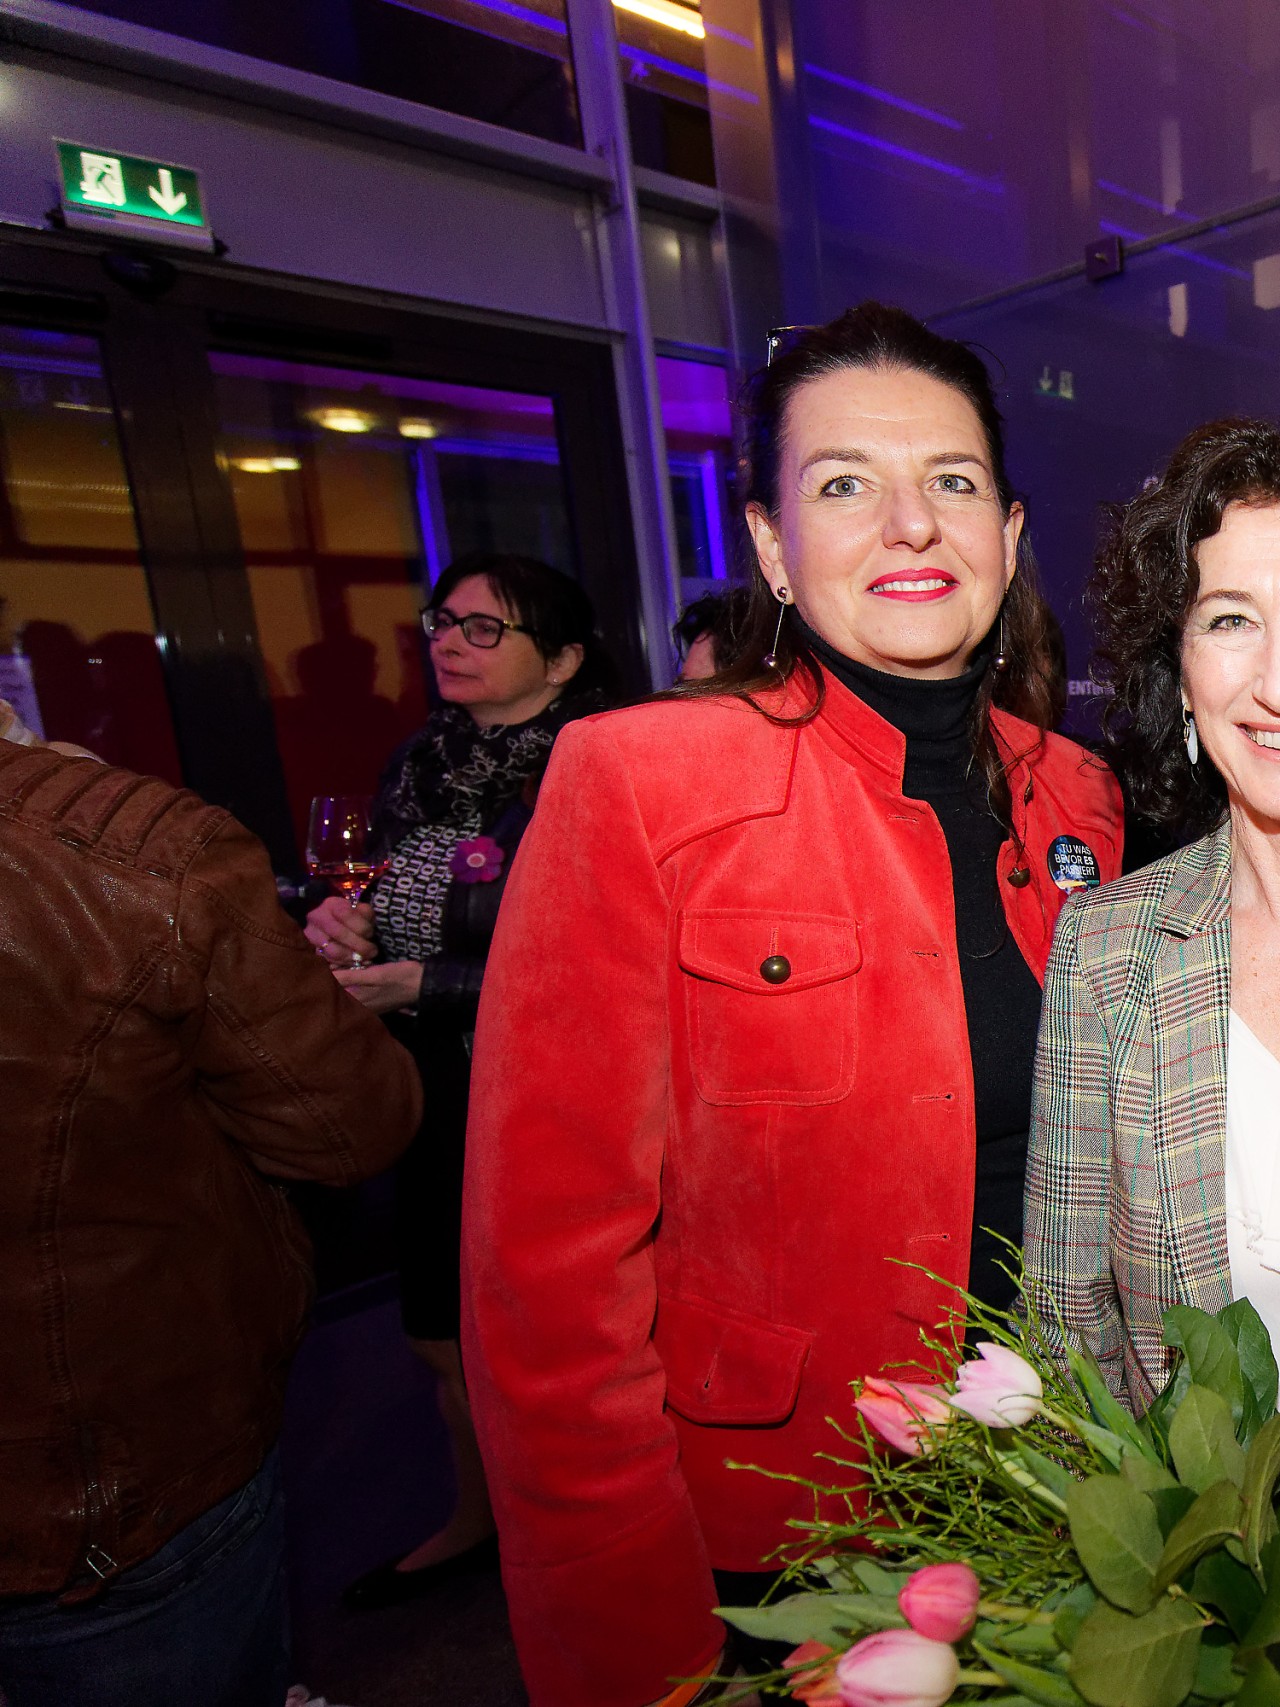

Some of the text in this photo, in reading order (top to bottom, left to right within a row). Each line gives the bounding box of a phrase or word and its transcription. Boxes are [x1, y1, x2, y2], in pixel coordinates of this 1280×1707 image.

[1060, 843, 1091, 855] TU WAS
[1054, 853, 1093, 865] BEVOR ES
[1059, 864, 1095, 876] PASSIERT
